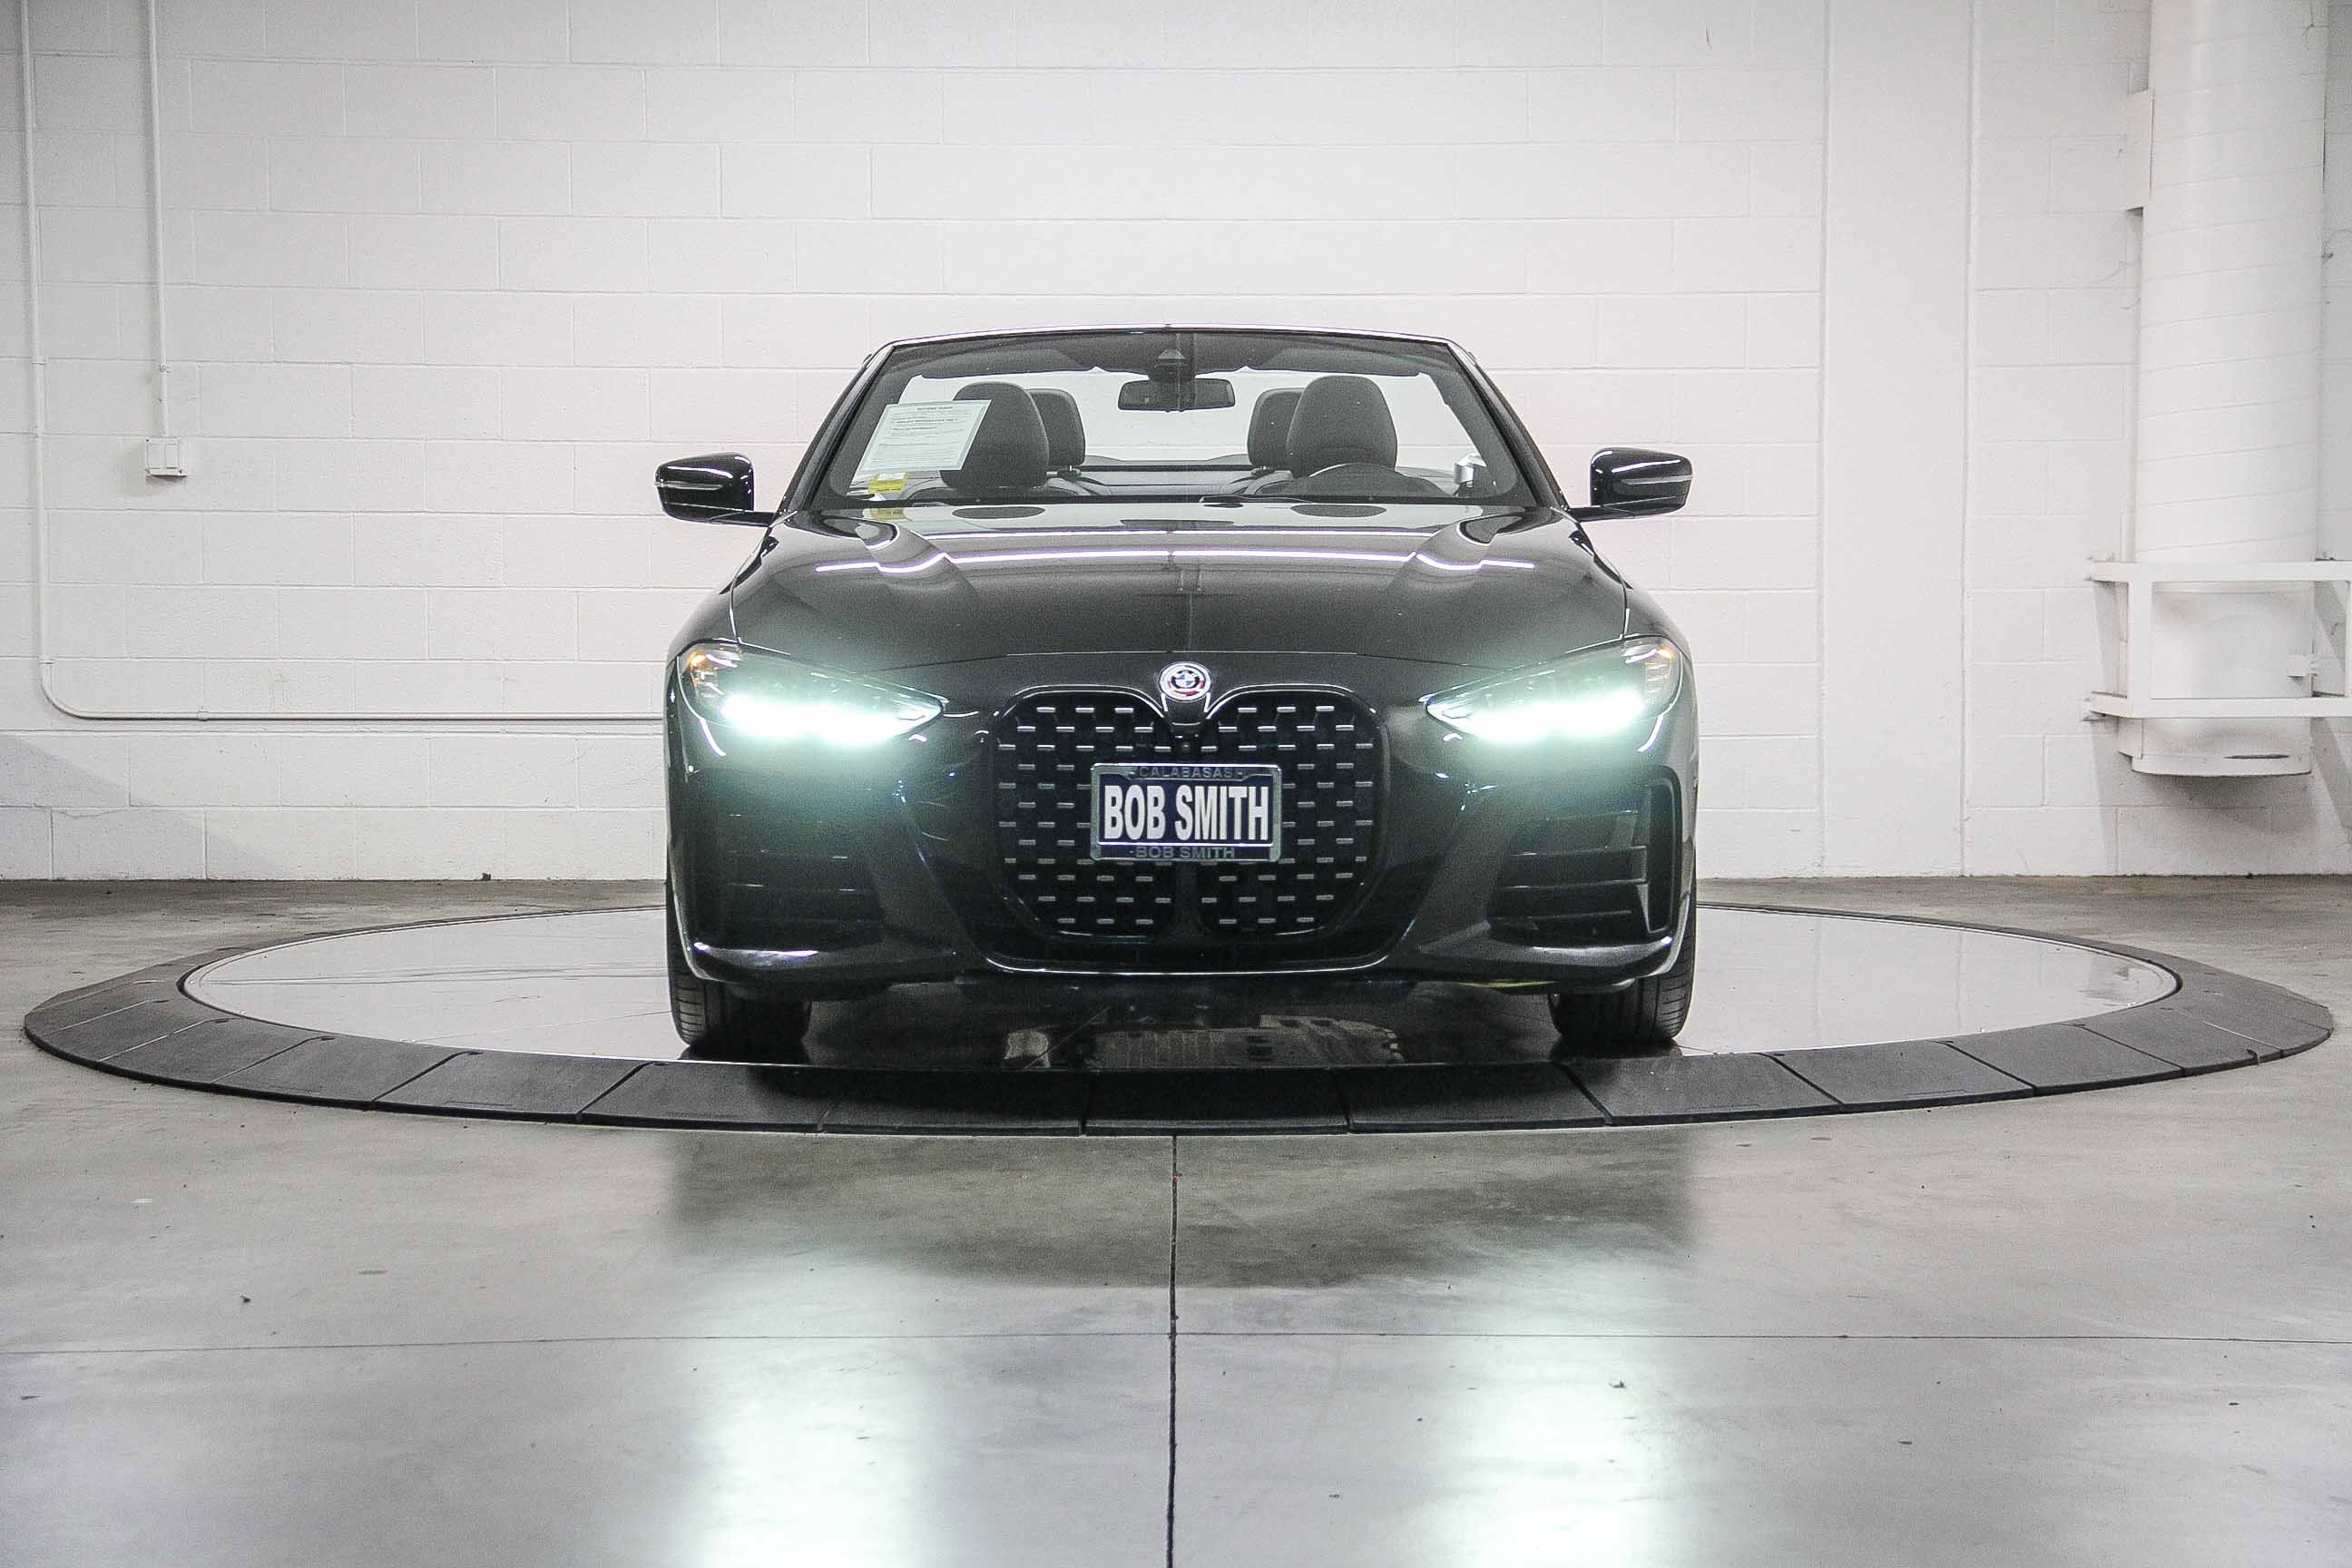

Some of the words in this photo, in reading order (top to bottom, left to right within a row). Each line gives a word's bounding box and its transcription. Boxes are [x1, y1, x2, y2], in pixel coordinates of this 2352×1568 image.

[1139, 766, 1234, 779] CALABASAS
[1104, 784, 1166, 840] BOB
[1174, 784, 1269, 840] SMITH
[1136, 846, 1174, 858] BOB
[1179, 846, 1235, 858] SMITH
